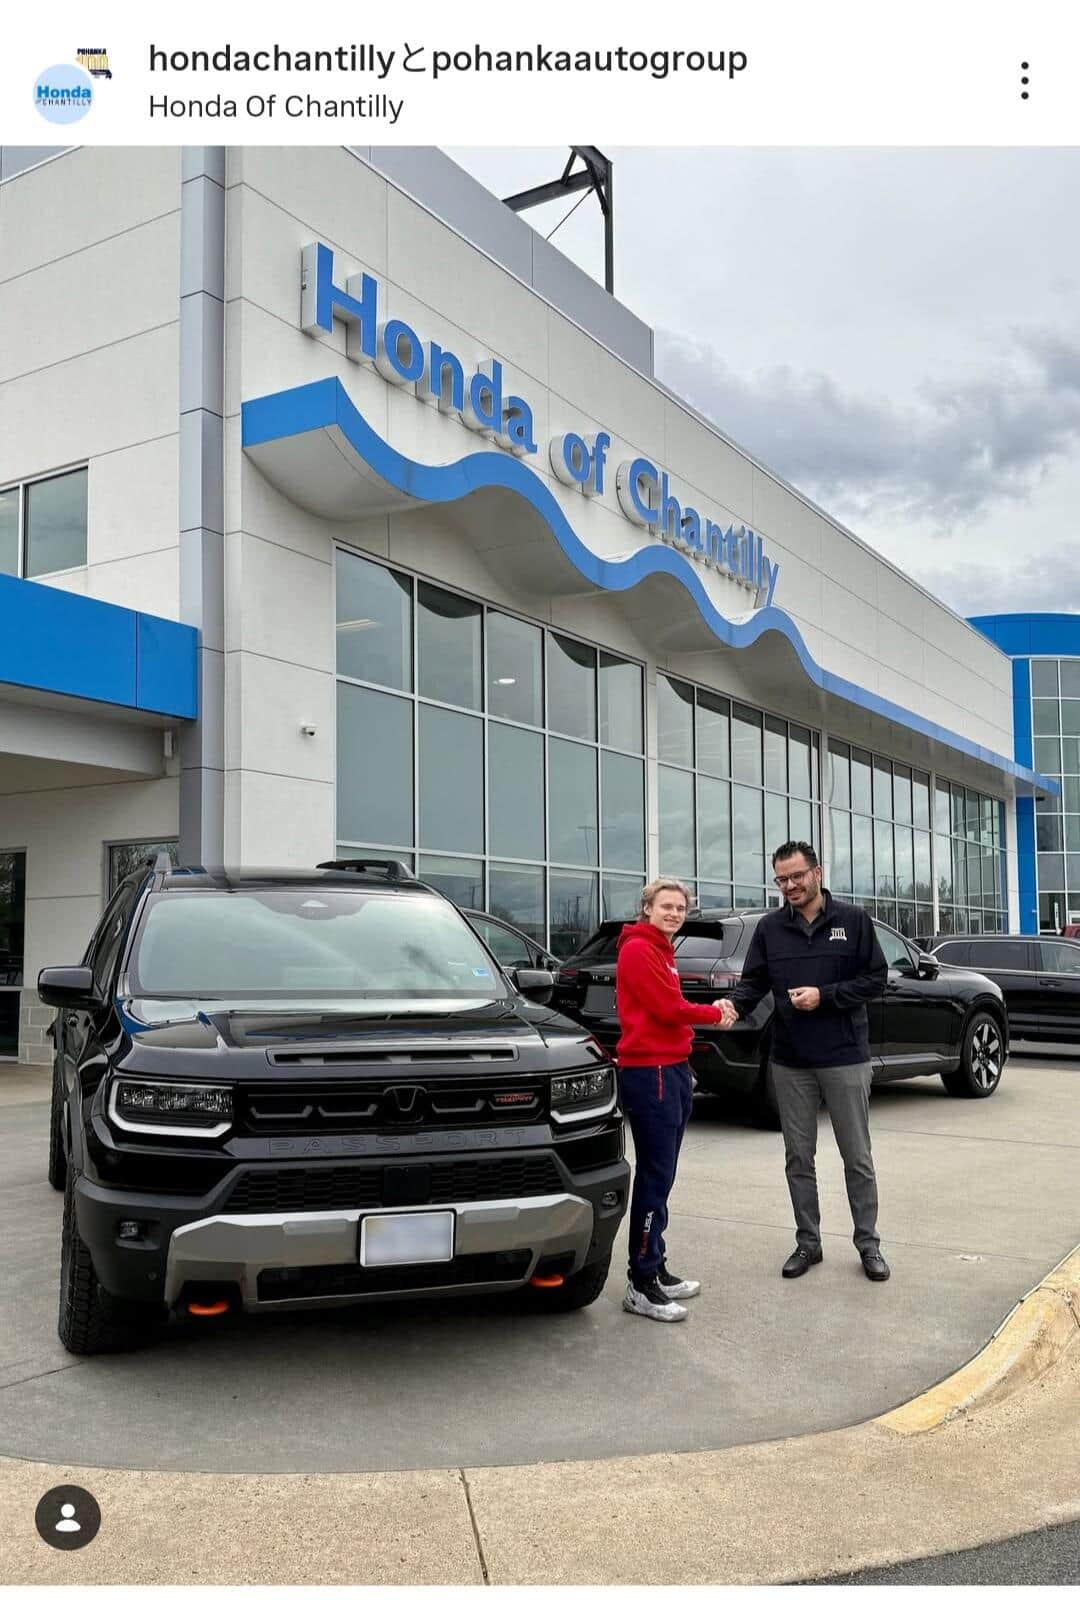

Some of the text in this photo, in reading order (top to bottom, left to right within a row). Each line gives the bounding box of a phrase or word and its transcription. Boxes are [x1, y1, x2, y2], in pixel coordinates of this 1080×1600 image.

[308, 242, 780, 608] Honda of Chantilly
[269, 1130, 528, 1157] PASSPORT
